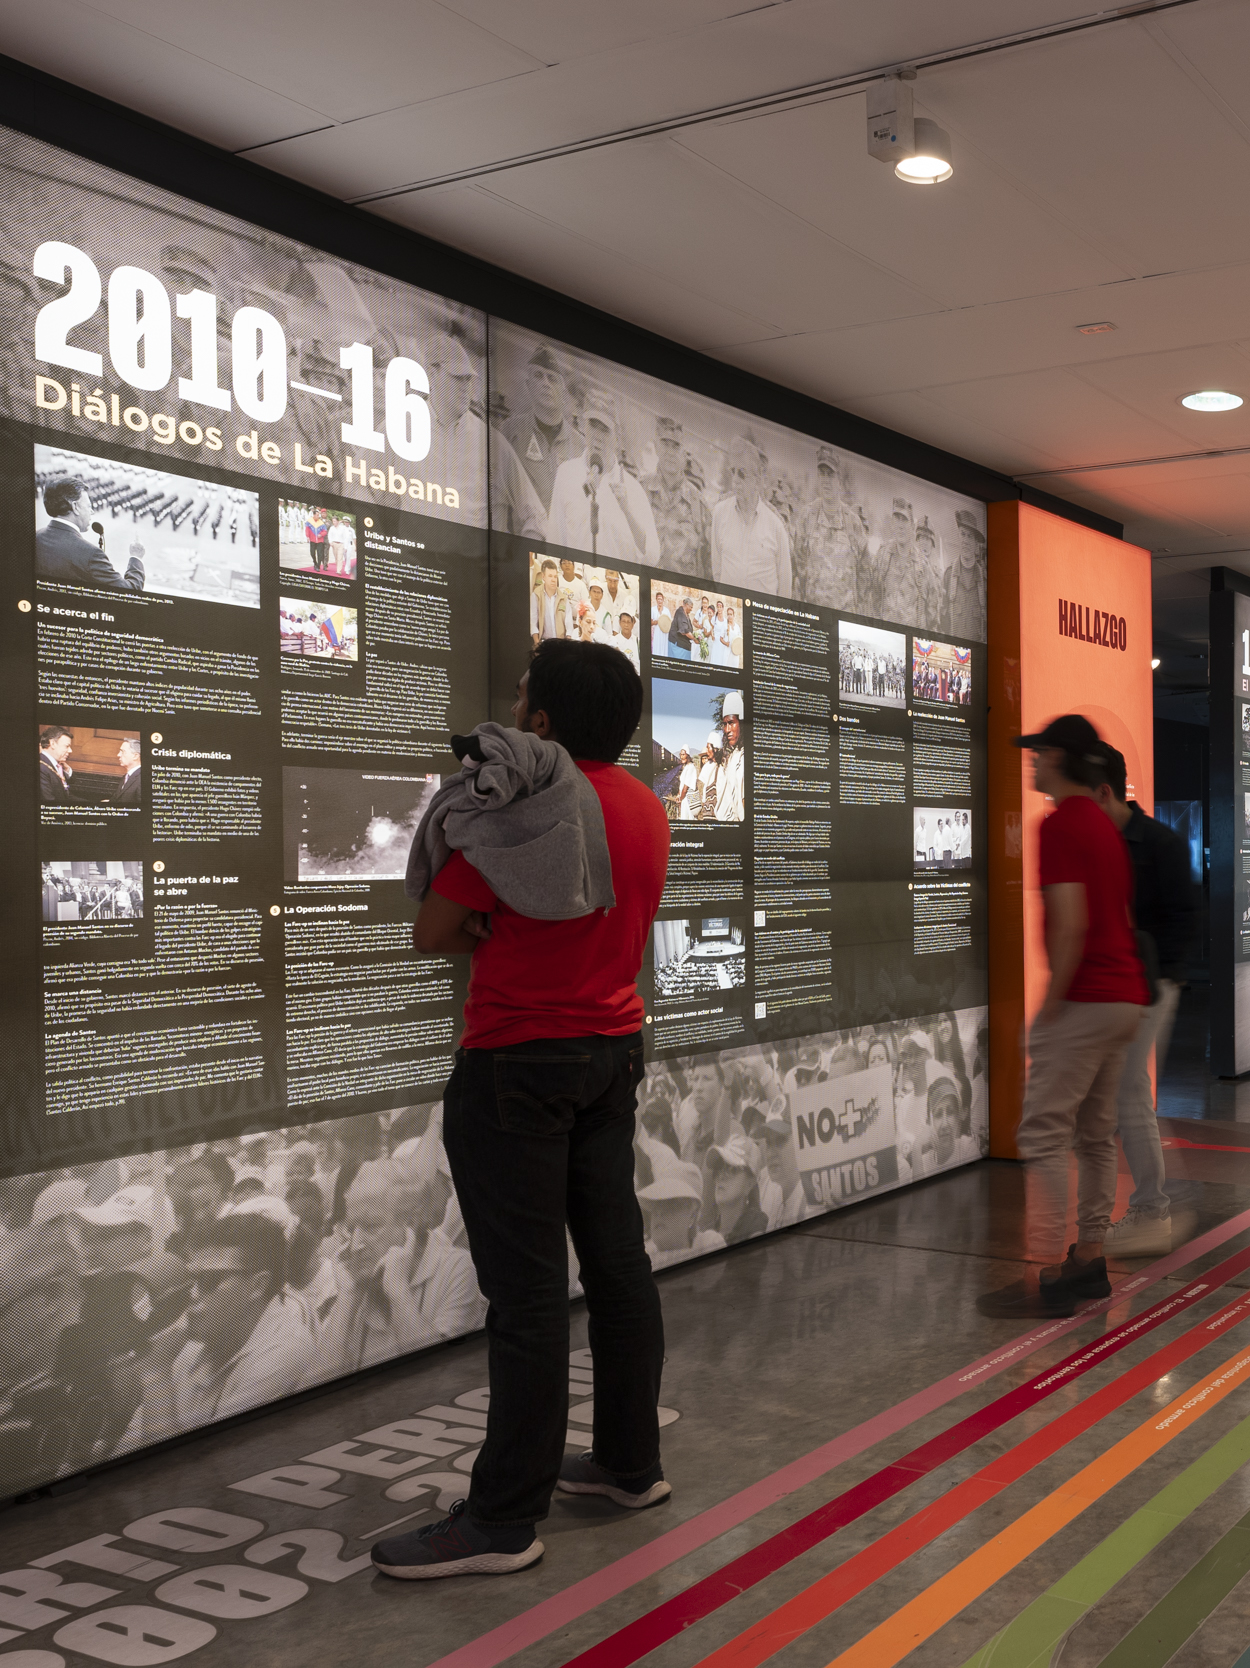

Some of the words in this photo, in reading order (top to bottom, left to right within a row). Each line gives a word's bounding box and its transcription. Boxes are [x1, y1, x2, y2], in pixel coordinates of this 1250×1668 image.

[36, 376, 222, 450] Diálogos
[236, 431, 281, 464] de
[295, 443, 332, 477] La
[346, 457, 459, 508] Habana
[364, 530, 384, 541] Uribe
[386, 536, 390, 544] y
[392, 536, 416, 547] Santos
[364, 541, 401, 553] distancian
[37, 604, 50, 614] Se
[53, 608, 87, 618] acerca
[89, 610, 98, 619] el
[101, 612, 115, 621] fin
[1058, 598, 1127, 652] HALLAZGO
[1242, 679, 1249, 692] El
[152, 748, 177, 757] Crisis
[179, 749, 231, 761] diplomática
[154, 876, 165, 884] La
[168, 876, 197, 886] puerta
[199, 875, 211, 883] de
[212, 875, 221, 883] la
[223, 876, 239, 885] paz
[167, 887, 188, 895] abre
[284, 906, 294, 914] La
[296, 905, 336, 915] Operación
[338, 903, 368, 912] Sodoma
[664, 1012, 683, 1020] víctimas
[710, 1006, 723, 1014] social
[1149, 1302, 1178, 1319] conflicto
[1126, 1317, 1154, 1333] armado
[1204, 1309, 1239, 1330] impunidad
[1090, 1336, 1121, 1353] expresa
[990, 1345, 1028, 1364] conflicto
[1070, 1358, 1088, 1367] los
[958, 1364, 993, 1382] armado
[1033, 1366, 1075, 1390] territorios
[1211, 1378, 1227, 1388] del
[1182, 1386, 1216, 1410] conflicto
[1155, 1409, 1187, 1431] armado
